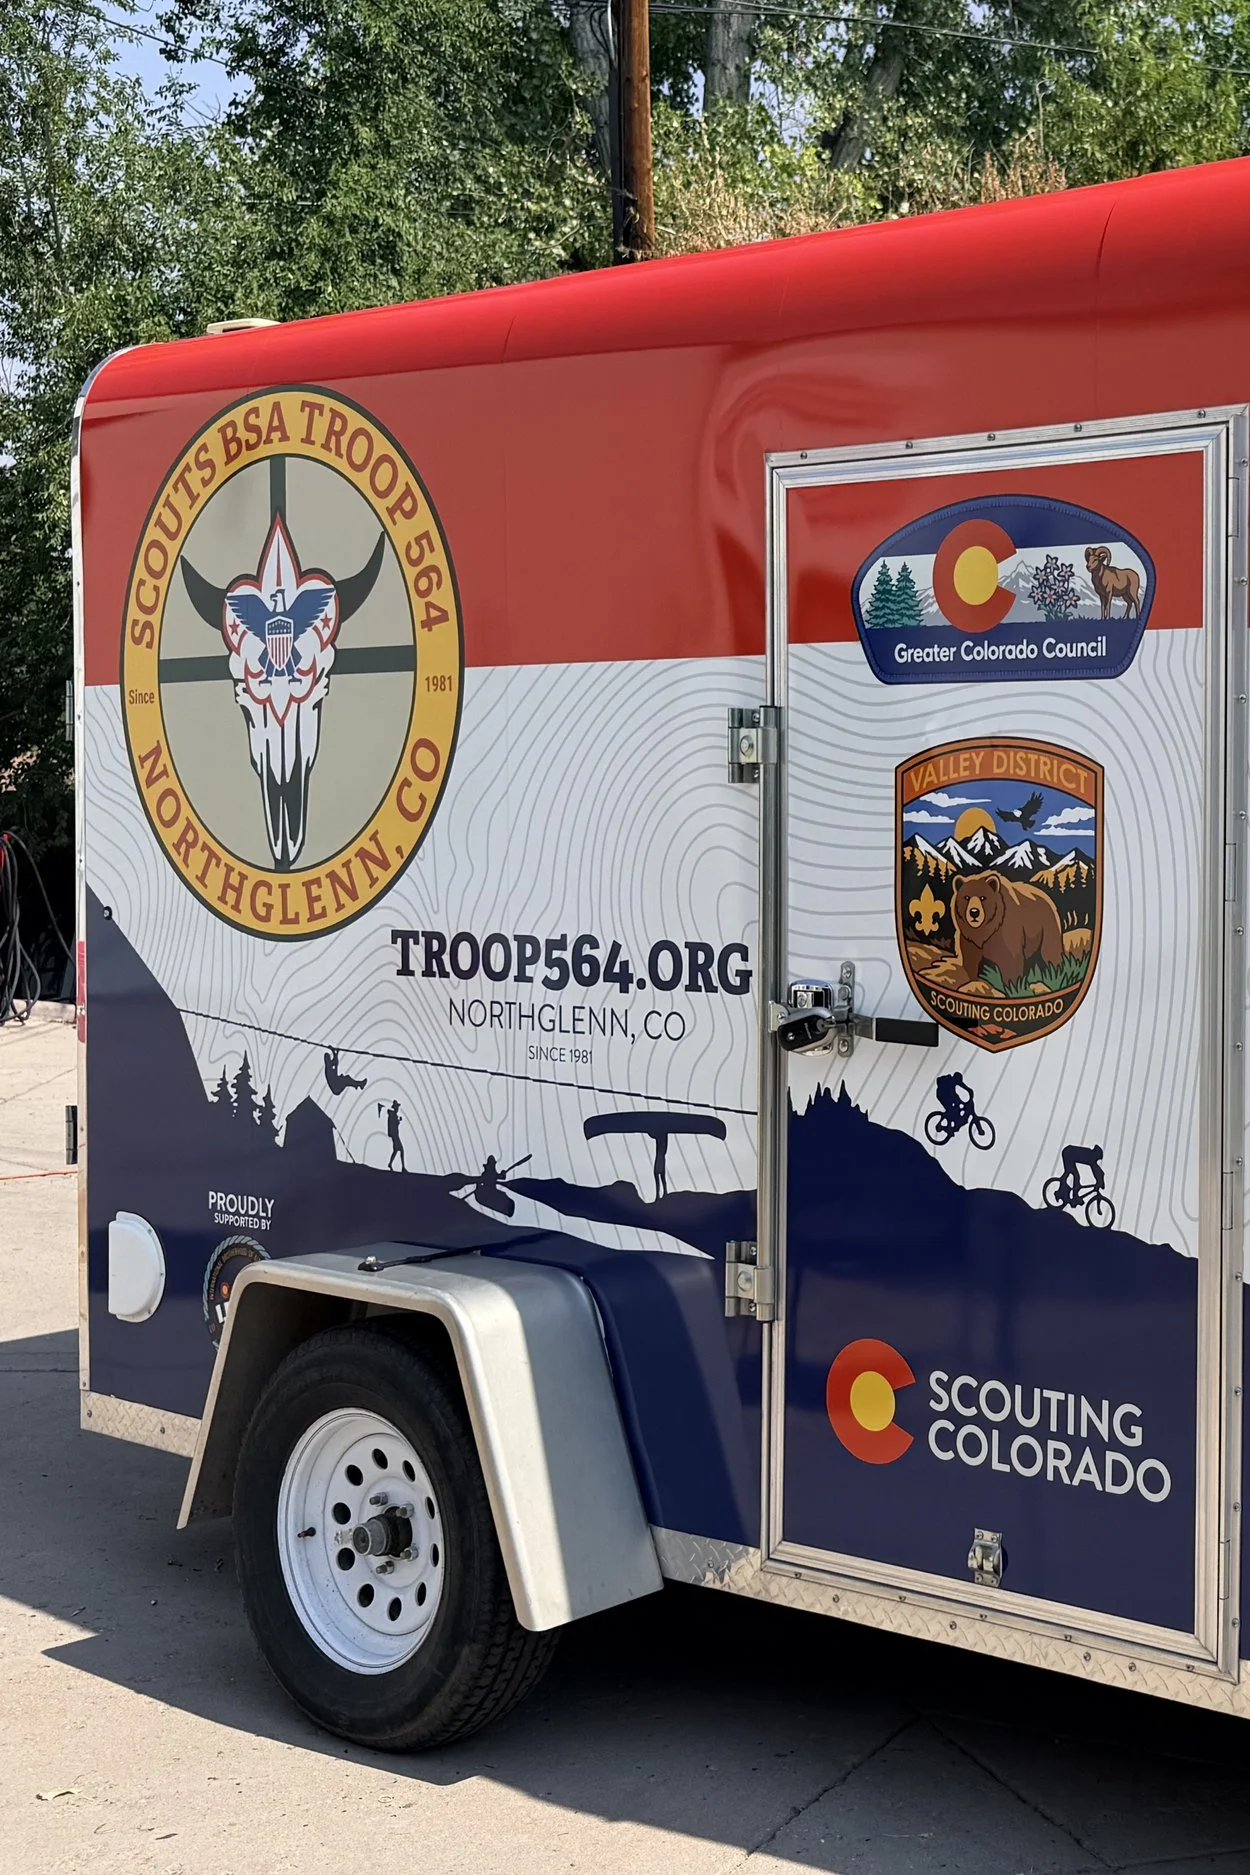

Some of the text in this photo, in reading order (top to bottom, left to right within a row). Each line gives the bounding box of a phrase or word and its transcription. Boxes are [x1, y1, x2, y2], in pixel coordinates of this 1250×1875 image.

[131, 400, 450, 650] SCOUTS BSA TROOP 564
[894, 636, 1106, 664] Greater Colorado Council
[128, 688, 155, 706] Since
[425, 675, 454, 693] 1981
[909, 750, 1088, 794] VALLEY DISTRICT
[137, 737, 441, 926] NORTHGLENN, CO
[391, 929, 753, 996] TROOP564.ORG
[449, 997, 686, 1045] NORTHGLENN, CO
[930, 990, 1064, 1023] SCOUTING COLORADO
[528, 1045, 593, 1064] SINCE 1981
[208, 1191, 274, 1217] PROUDLY
[214, 1212, 272, 1231] SUPPORTED BY
[928, 1370, 1143, 1447] SCOUTING
[928, 1419, 1172, 1503] COLORADO
